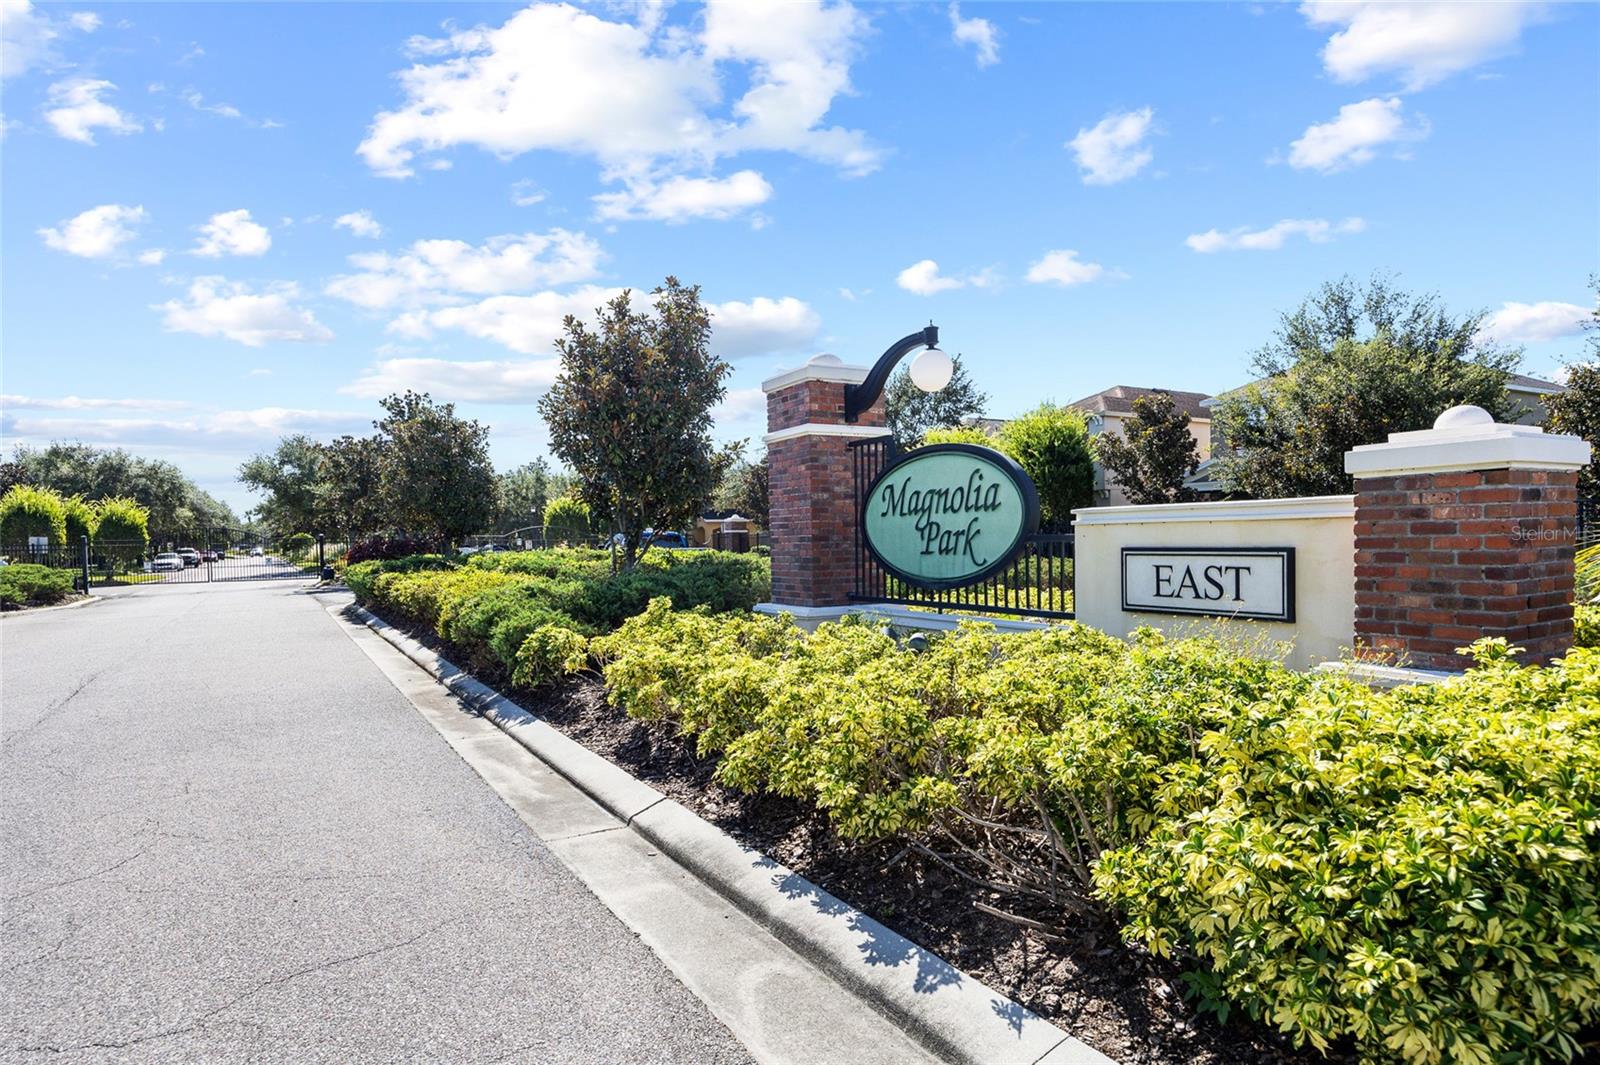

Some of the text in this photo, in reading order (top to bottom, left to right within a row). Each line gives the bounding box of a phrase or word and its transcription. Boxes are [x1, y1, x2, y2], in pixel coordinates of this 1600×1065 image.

[881, 468, 1001, 531] Magnolia
[920, 517, 987, 566] Park
[1152, 564, 1252, 602] EAST
